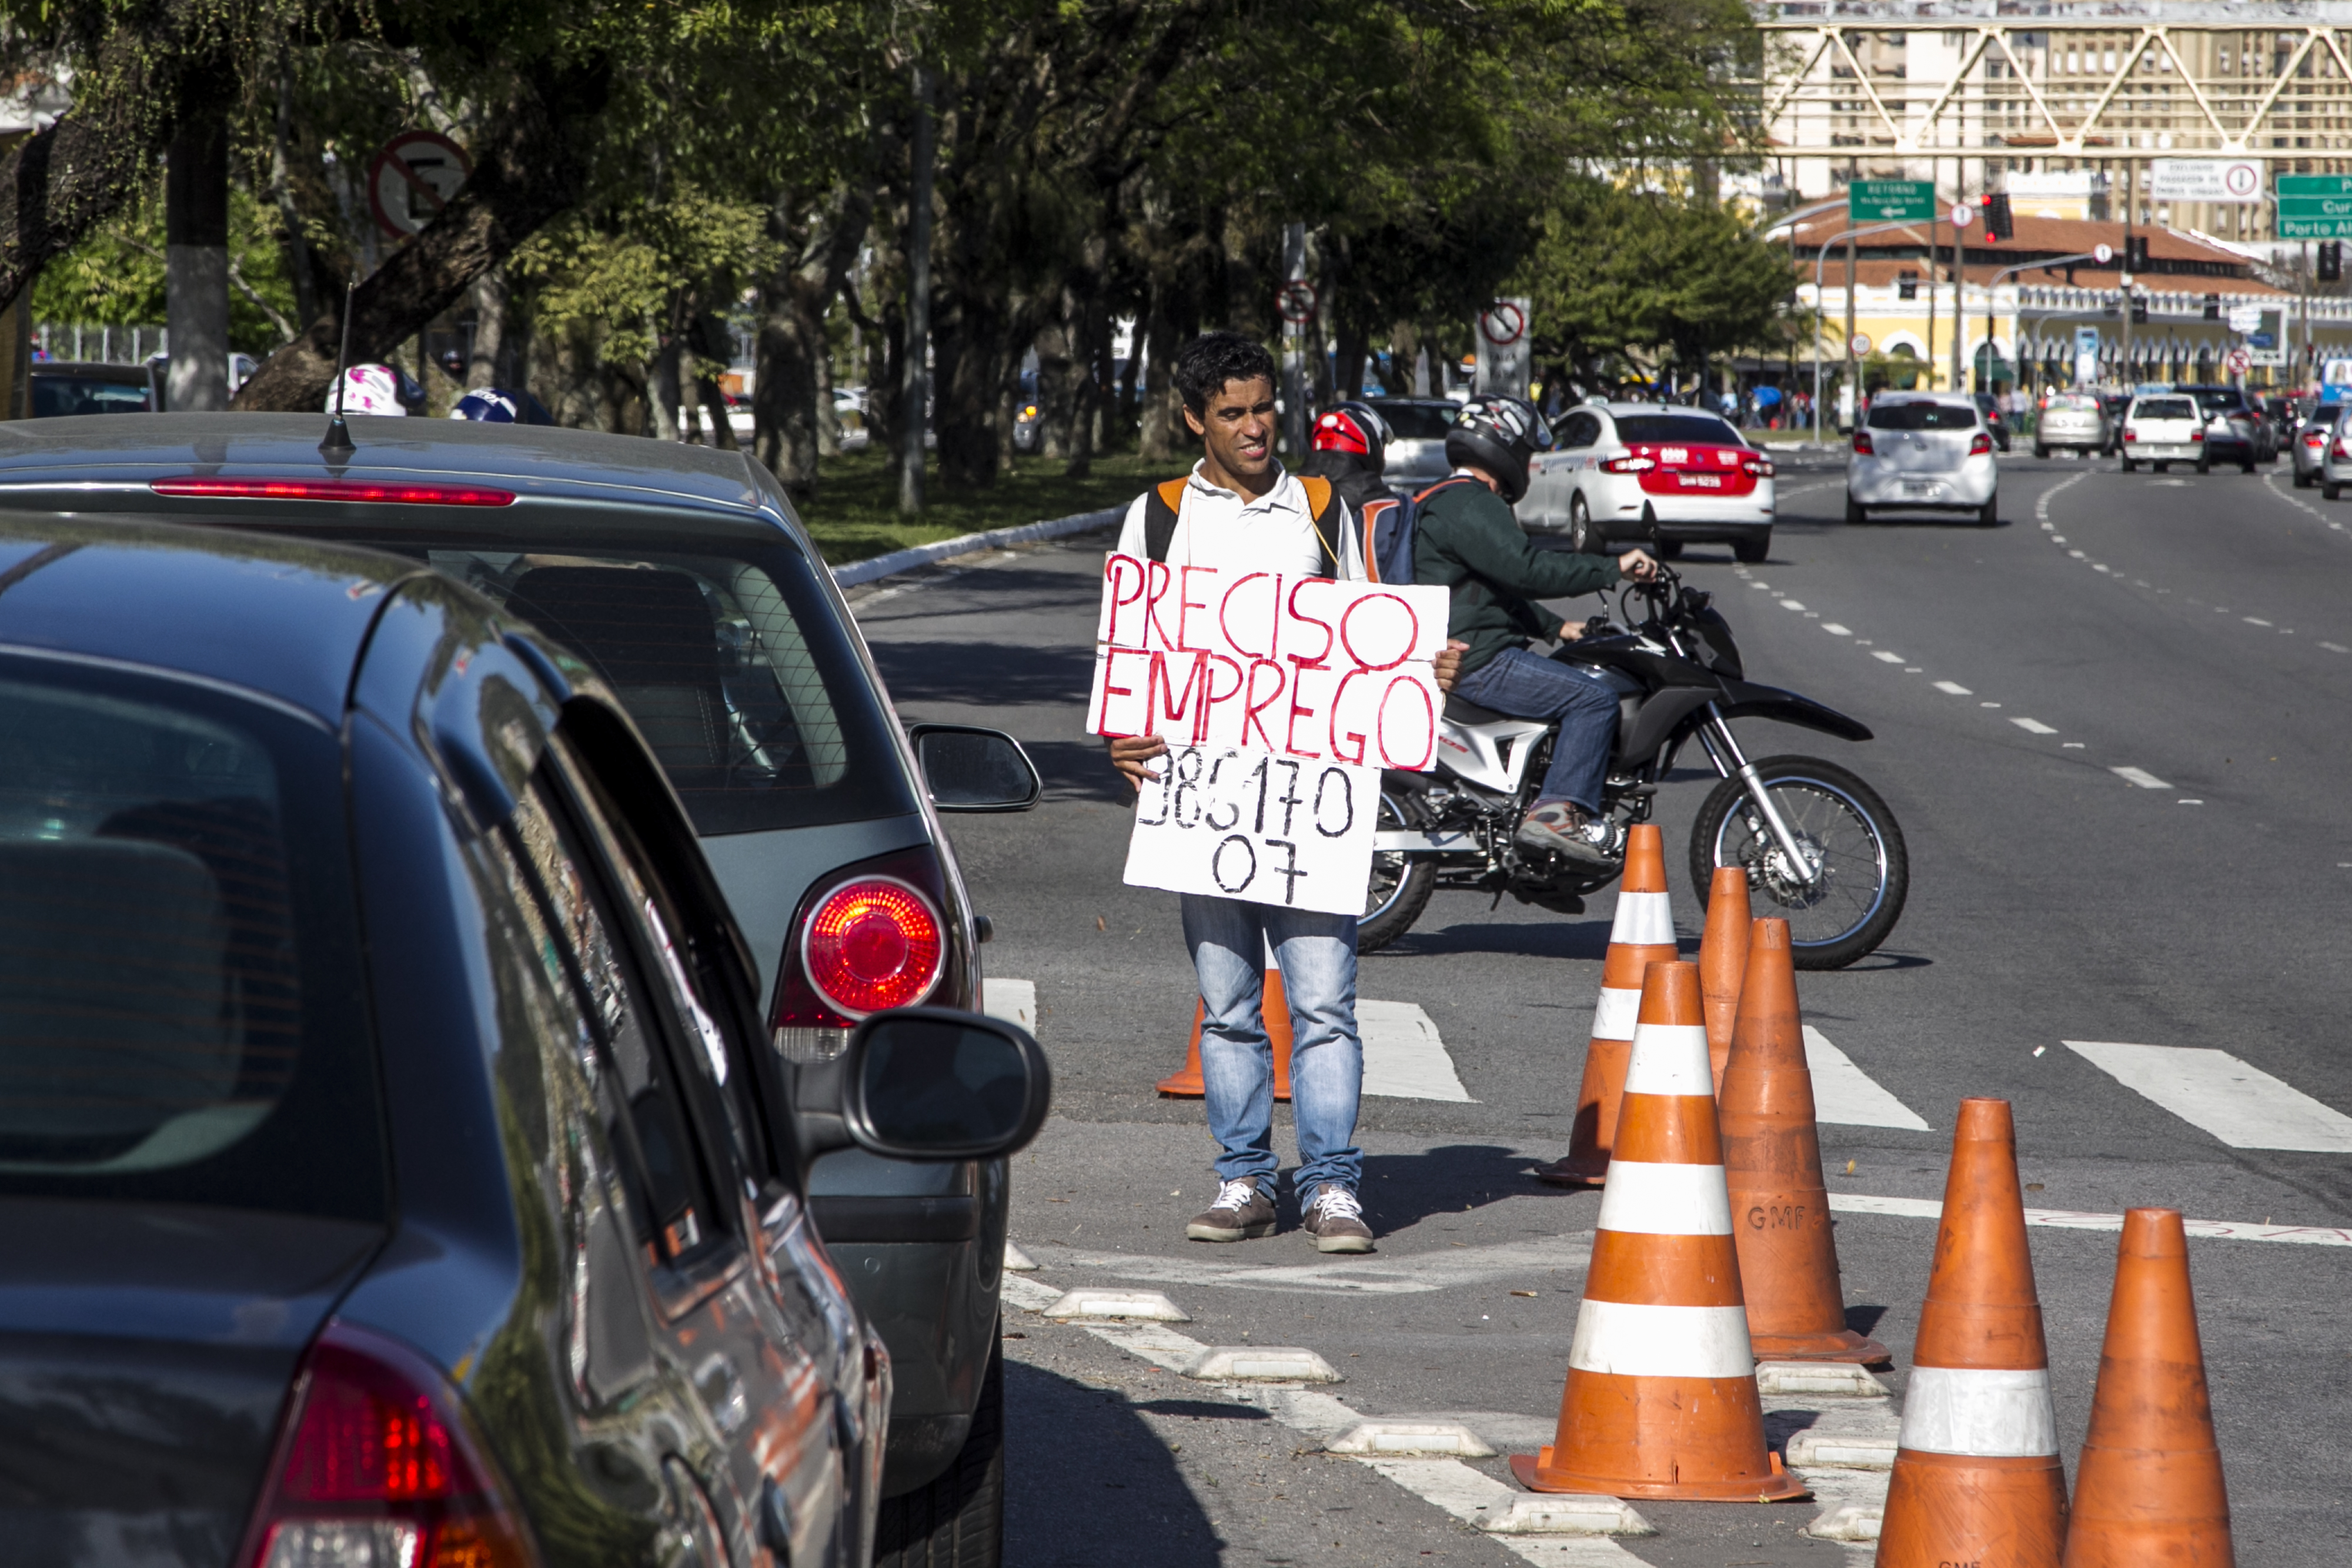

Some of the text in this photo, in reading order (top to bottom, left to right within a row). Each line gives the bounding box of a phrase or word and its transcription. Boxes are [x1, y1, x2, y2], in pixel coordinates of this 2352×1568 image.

[2284, 221, 2331, 236] Porto
[1105, 554, 1418, 672] PRECISO
[1097, 647, 1434, 772] EMPREGO
[1212, 834, 1308, 904] 07
[1747, 1205, 1805, 1230] GMF
